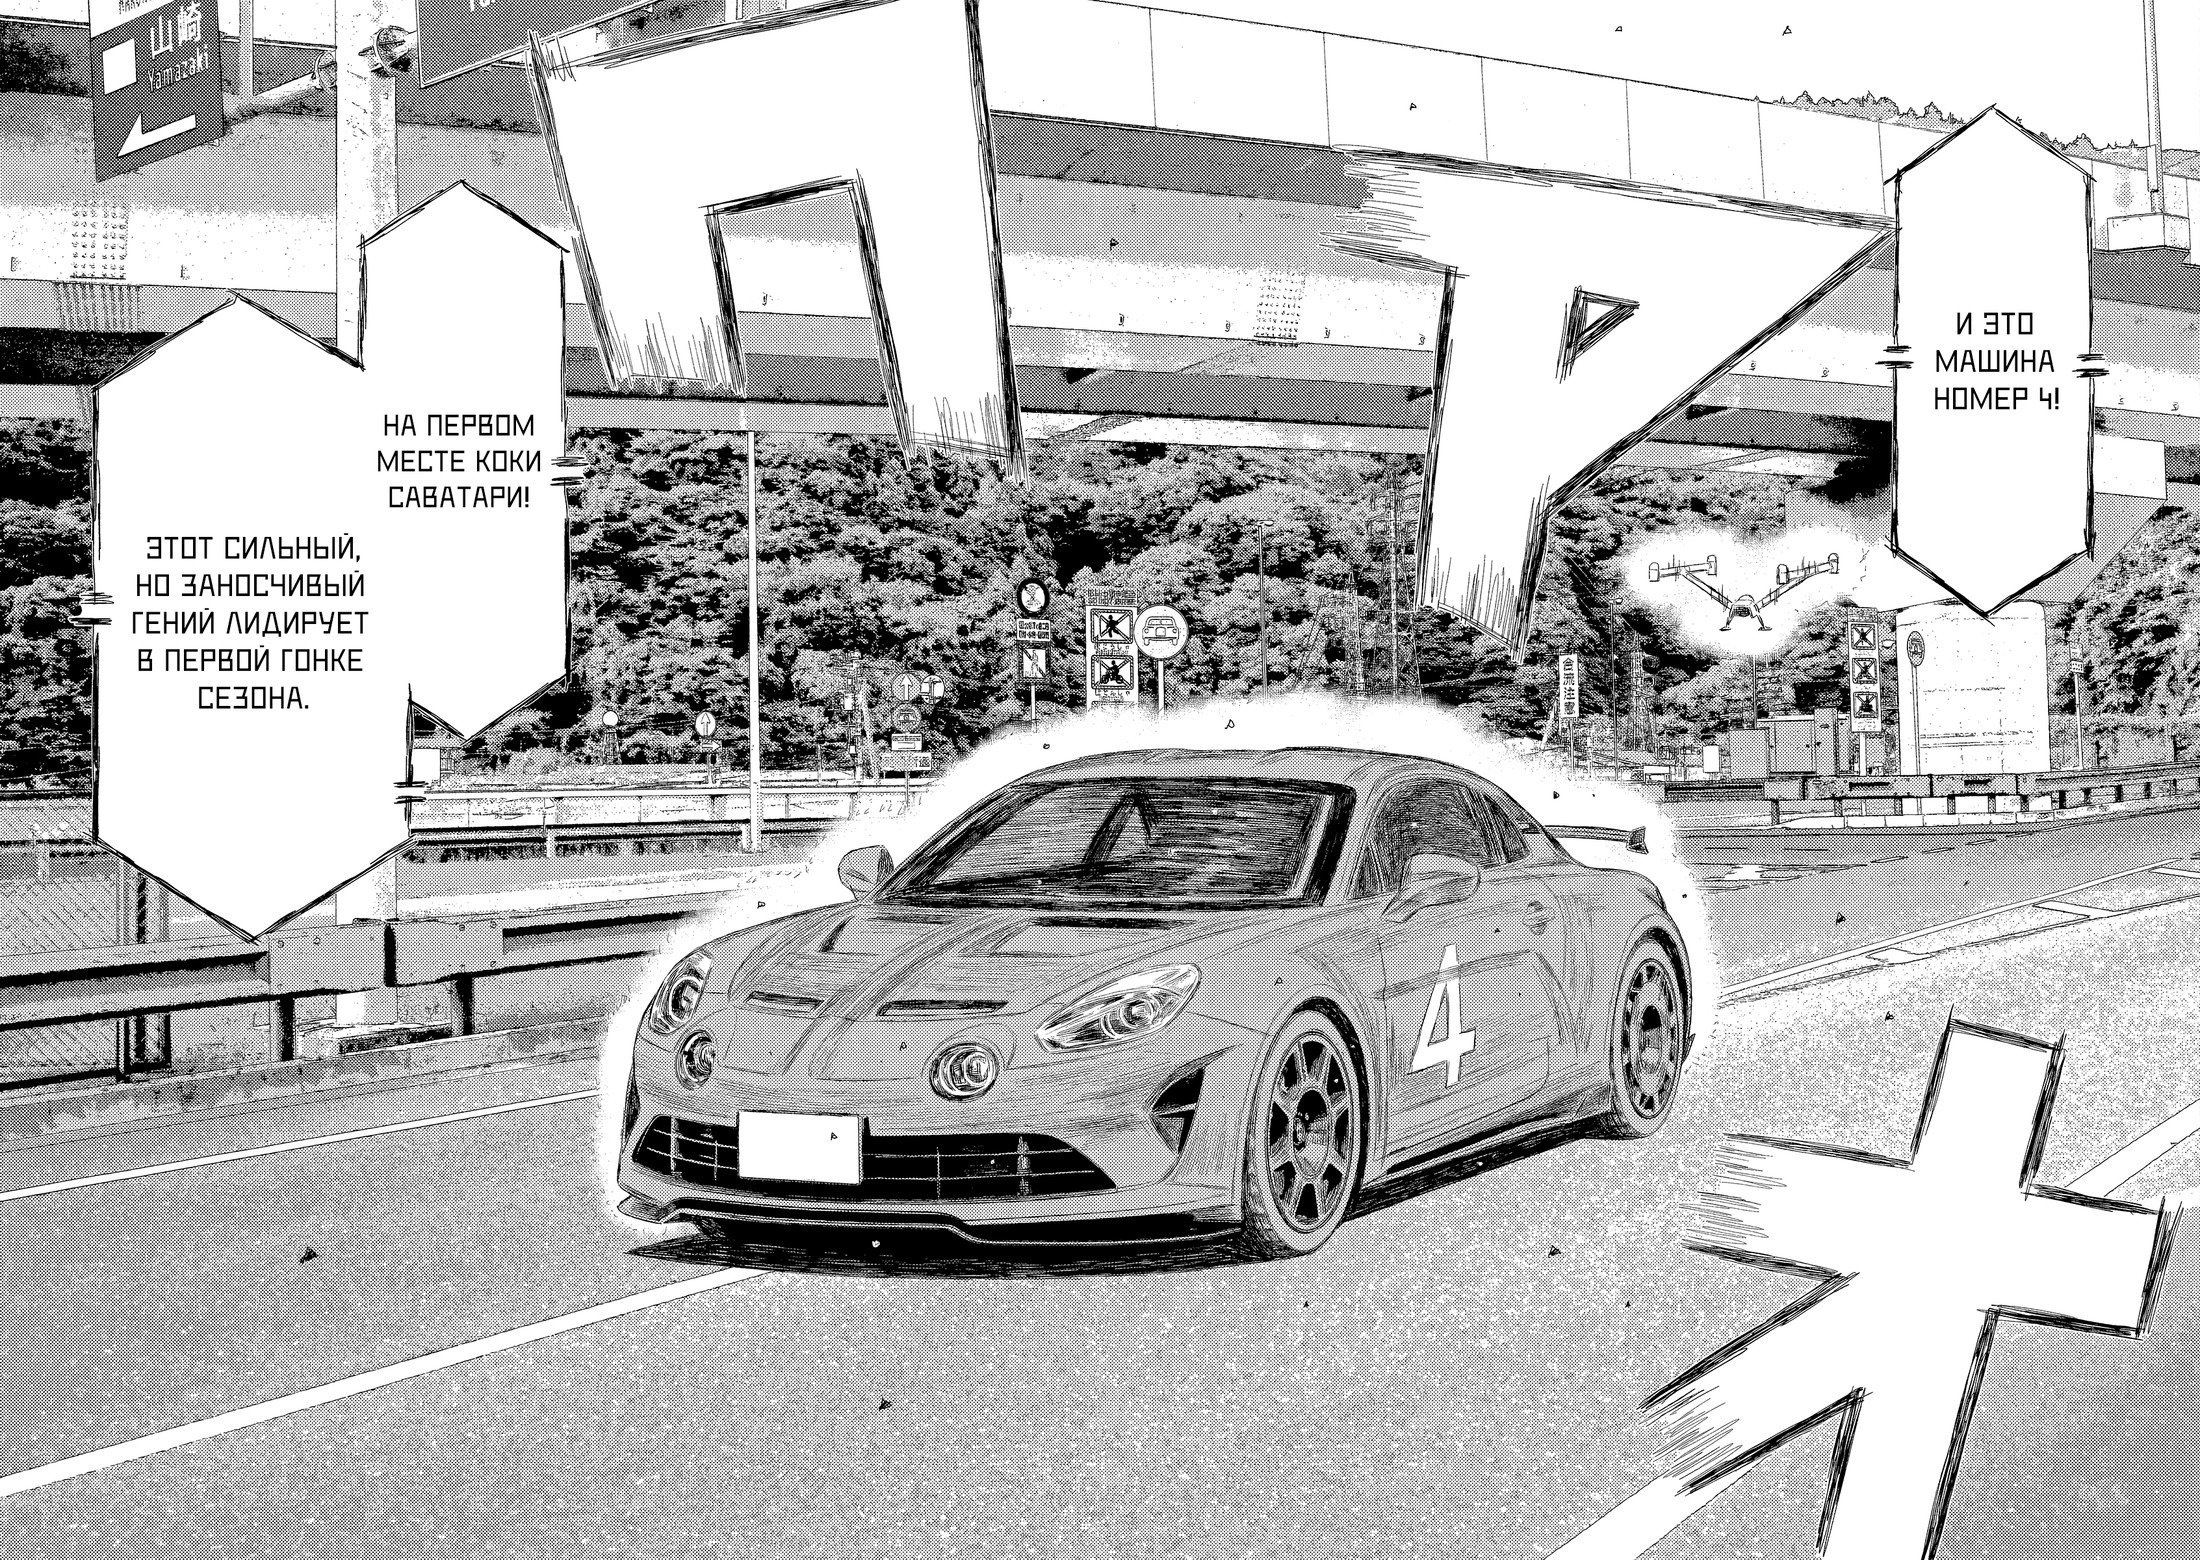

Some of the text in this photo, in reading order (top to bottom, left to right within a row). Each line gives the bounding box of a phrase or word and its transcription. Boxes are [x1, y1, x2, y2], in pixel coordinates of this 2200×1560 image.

[149, 2, 203, 60] 山崎
[147, 44, 209, 92] Yamazaki
[1956, 312, 2033, 335] И ЭТО
[1935, 349, 2055, 373] МАШИНА
[1934, 387, 2059, 410] НОМЕР 4!
[384, 414, 534, 437] НА ПЕРВОМ
[377, 450, 541, 472] МЕСТЕ КОКИ
[389, 486, 530, 508] САВАТАРИ!
[146, 532, 361, 563] ЭТОТ СИЛЬНЫЙ,
[136, 570, 365, 597] НО ЗАНОСЧИВЫЙ
[132, 607, 369, 638] ГЕНИЙ ЛИДИРУЕТ
[138, 644, 363, 672] В ПЕРВОЙ ГОНКЕ
[198, 686, 310, 710] СЕЗОНА.
[1407, 943, 1477, 1089] 4
